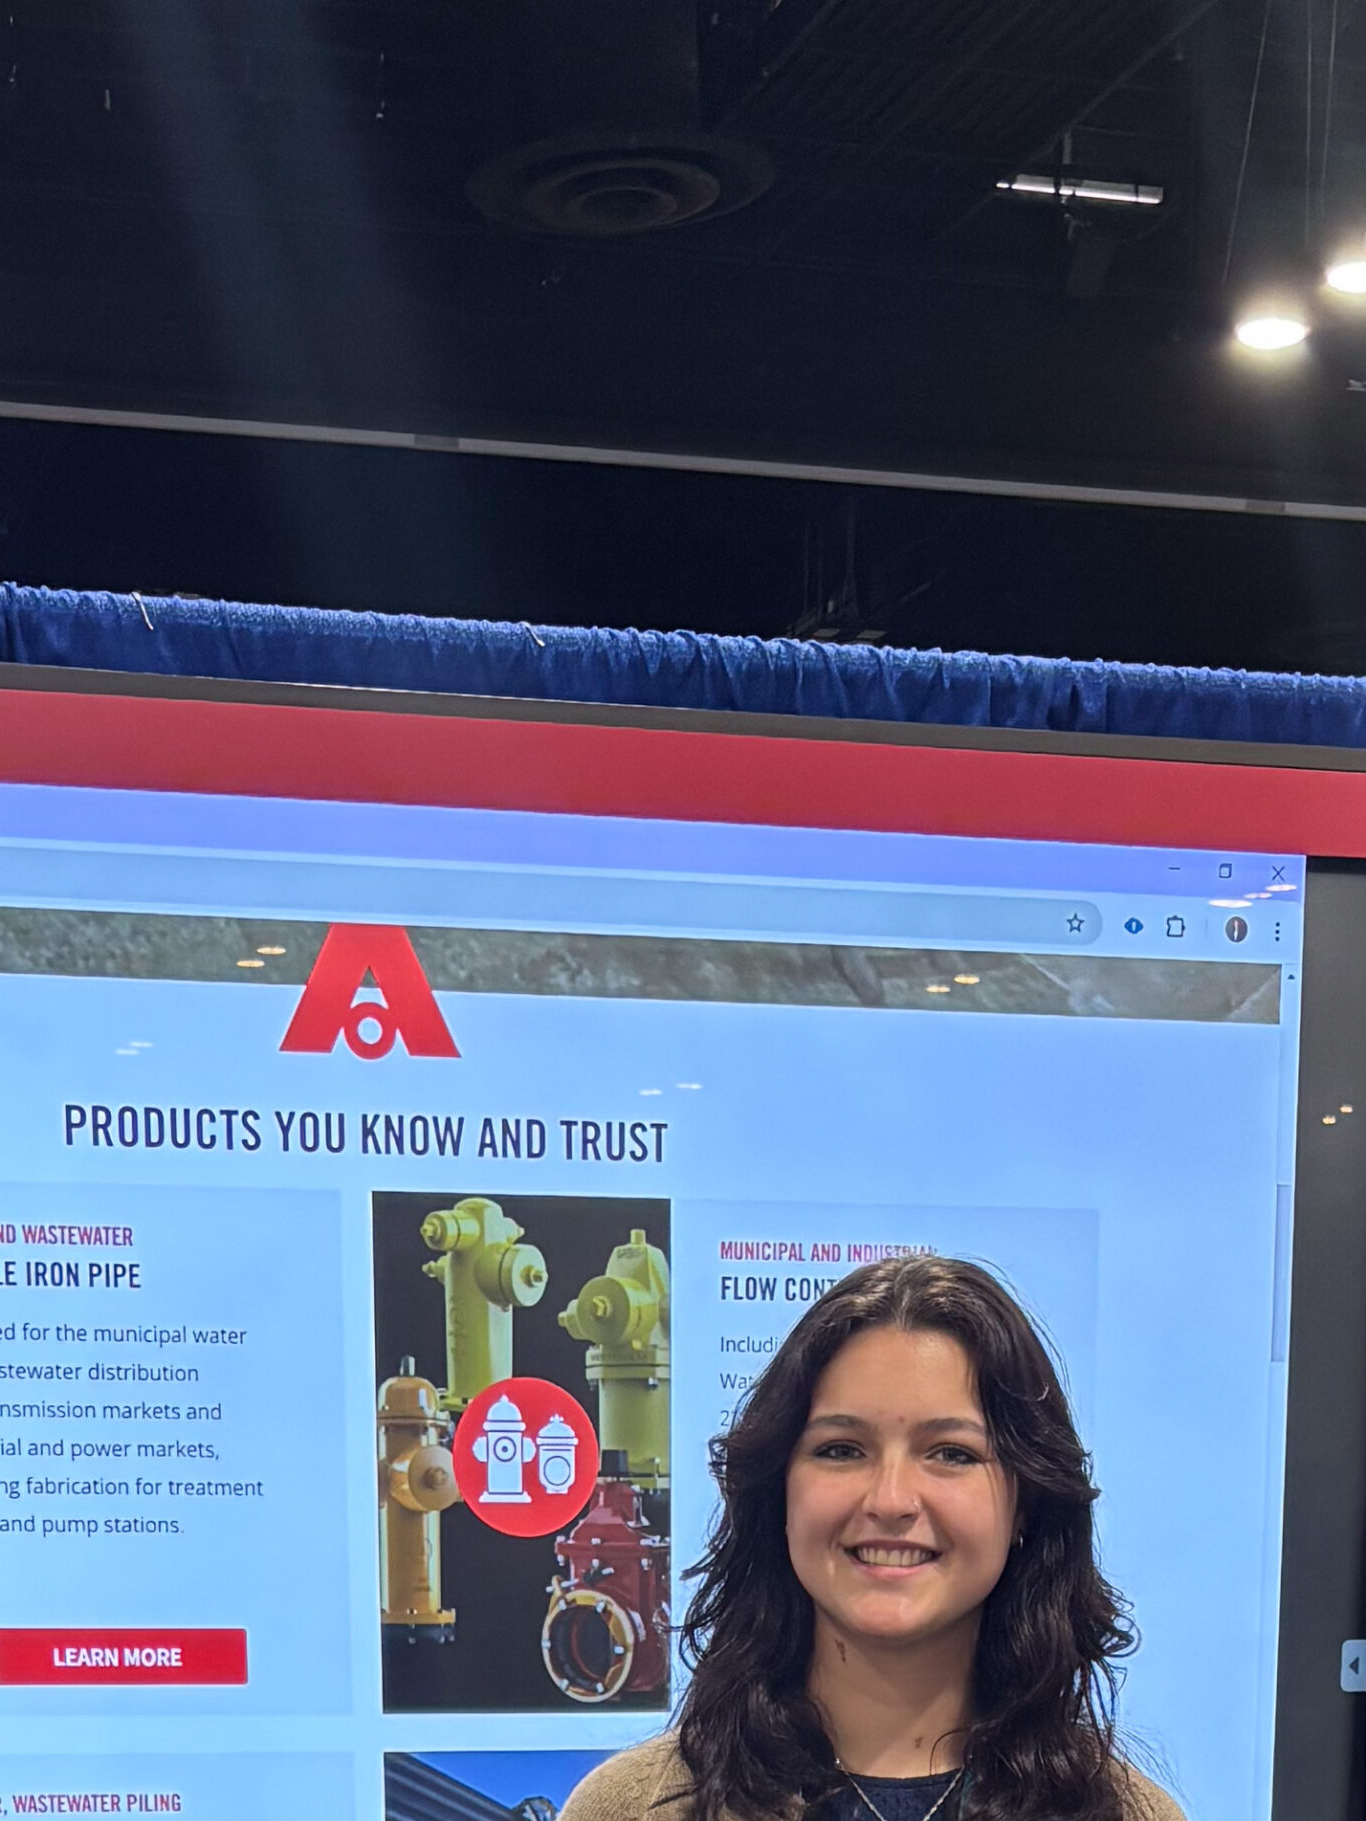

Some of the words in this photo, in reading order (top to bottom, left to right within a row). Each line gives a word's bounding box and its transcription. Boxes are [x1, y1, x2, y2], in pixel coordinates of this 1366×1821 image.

[66, 1104, 261, 1151] PRODUCTS
[275, 1110, 345, 1153] YOU
[362, 1114, 464, 1157] KNOW
[478, 1117, 545, 1159] AND
[560, 1120, 668, 1162] TRUST
[22, 1224, 133, 1247] WASTEWATER
[720, 1241, 805, 1262] MUNICIPAL
[810, 1242, 841, 1262] AND
[26, 1261, 79, 1288] IRON
[89, 1263, 141, 1288] PIPE
[720, 1277, 777, 1301] FLOW
[23, 1322, 50, 1340] for
[56, 1324, 87, 1342] the
[94, 1325, 186, 1346] municipal
[193, 1329, 247, 1345] water
[89, 1363, 198, 1382] distribution
[103, 1401, 180, 1419] markets
[187, 1402, 221, 1420] and
[28, 1439, 63, 1457] and
[71, 1443, 131, 1461] power
[138, 1440, 219, 1460] markets,
[27, 1477, 129, 1495] fabrication
[136, 1477, 162, 1495] for
[169, 1480, 263, 1497] treatment
[0, 1515, 35, 1532] and
[43, 1519, 98, 1537] pump
[54, 1647, 118, 1667] LEARN
[124, 1647, 182, 1667] MORE
[12, 1794, 121, 1813] WASTEWATER
[127, 1793, 181, 1812] PILING
